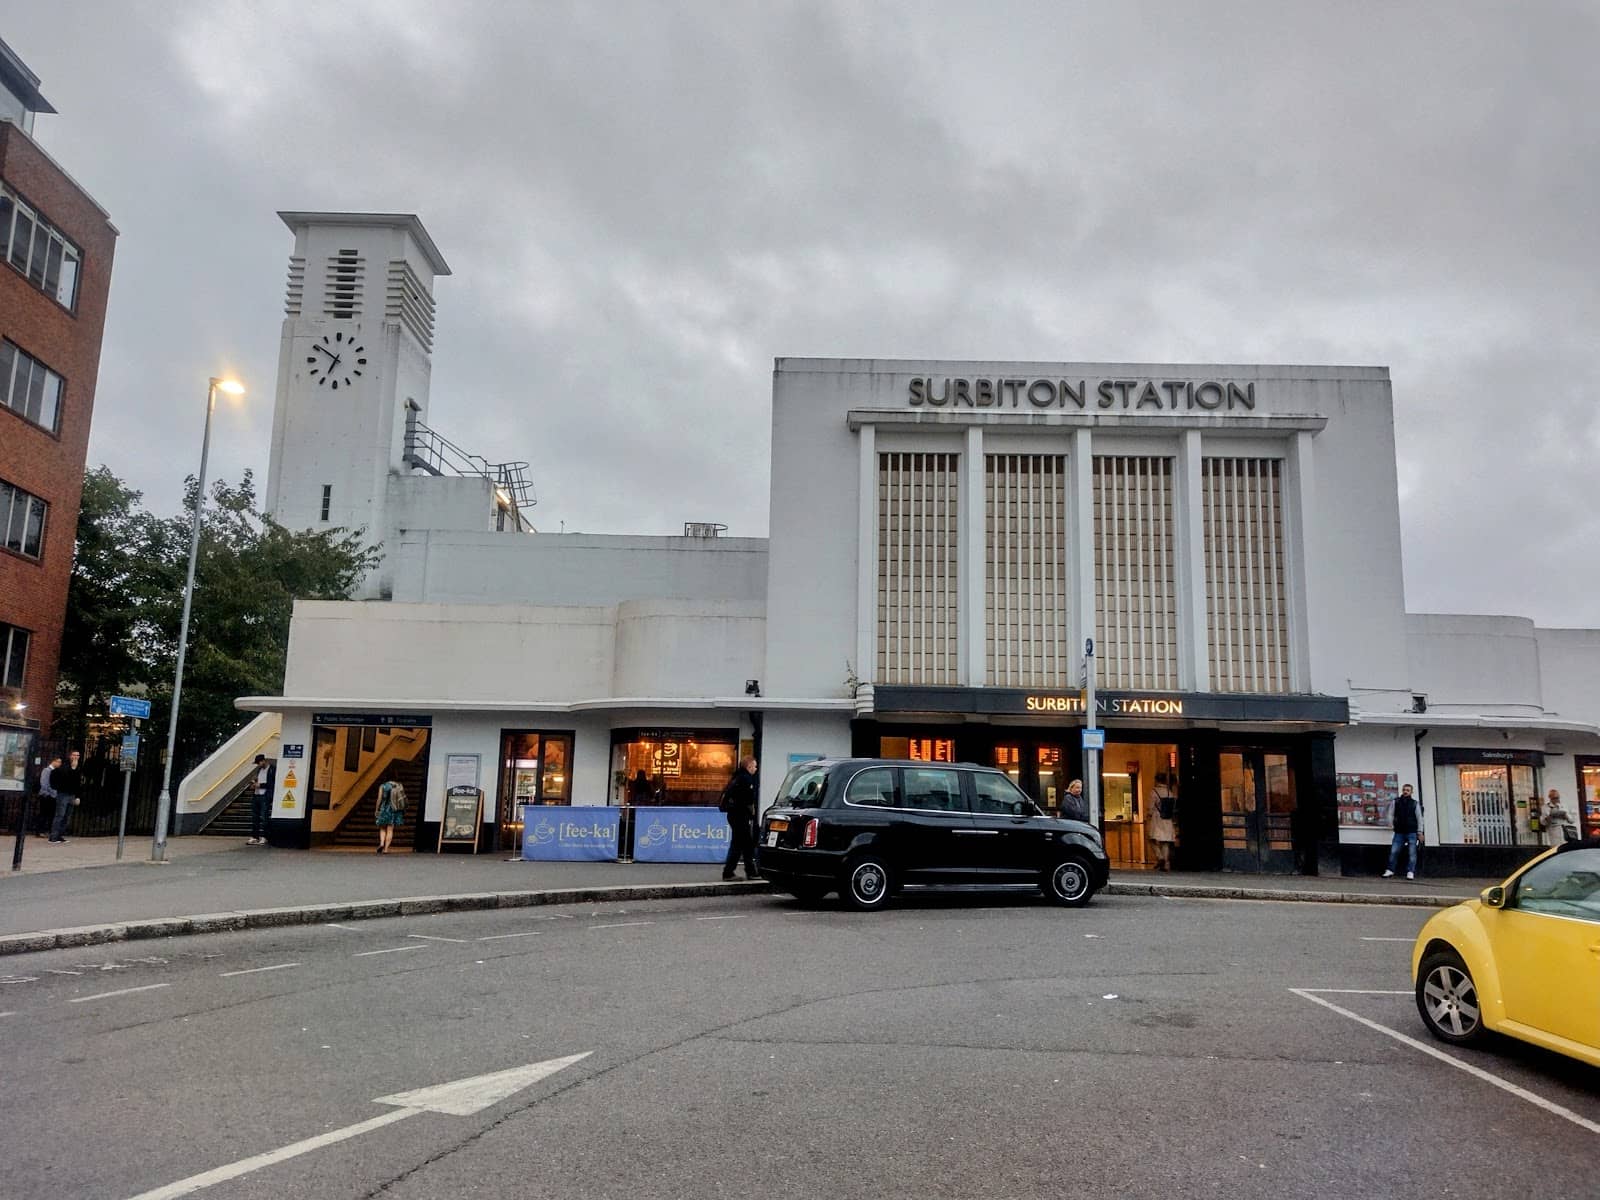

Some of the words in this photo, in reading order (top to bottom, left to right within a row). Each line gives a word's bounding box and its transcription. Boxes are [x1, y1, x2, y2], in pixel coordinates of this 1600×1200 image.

[908, 377, 1087, 409] SURBITON
[1097, 379, 1256, 411] STATION
[1112, 698, 1183, 714] STATION
[559, 823, 616, 842] [fee-ka]
[672, 823, 731, 842] [fee-ka]
